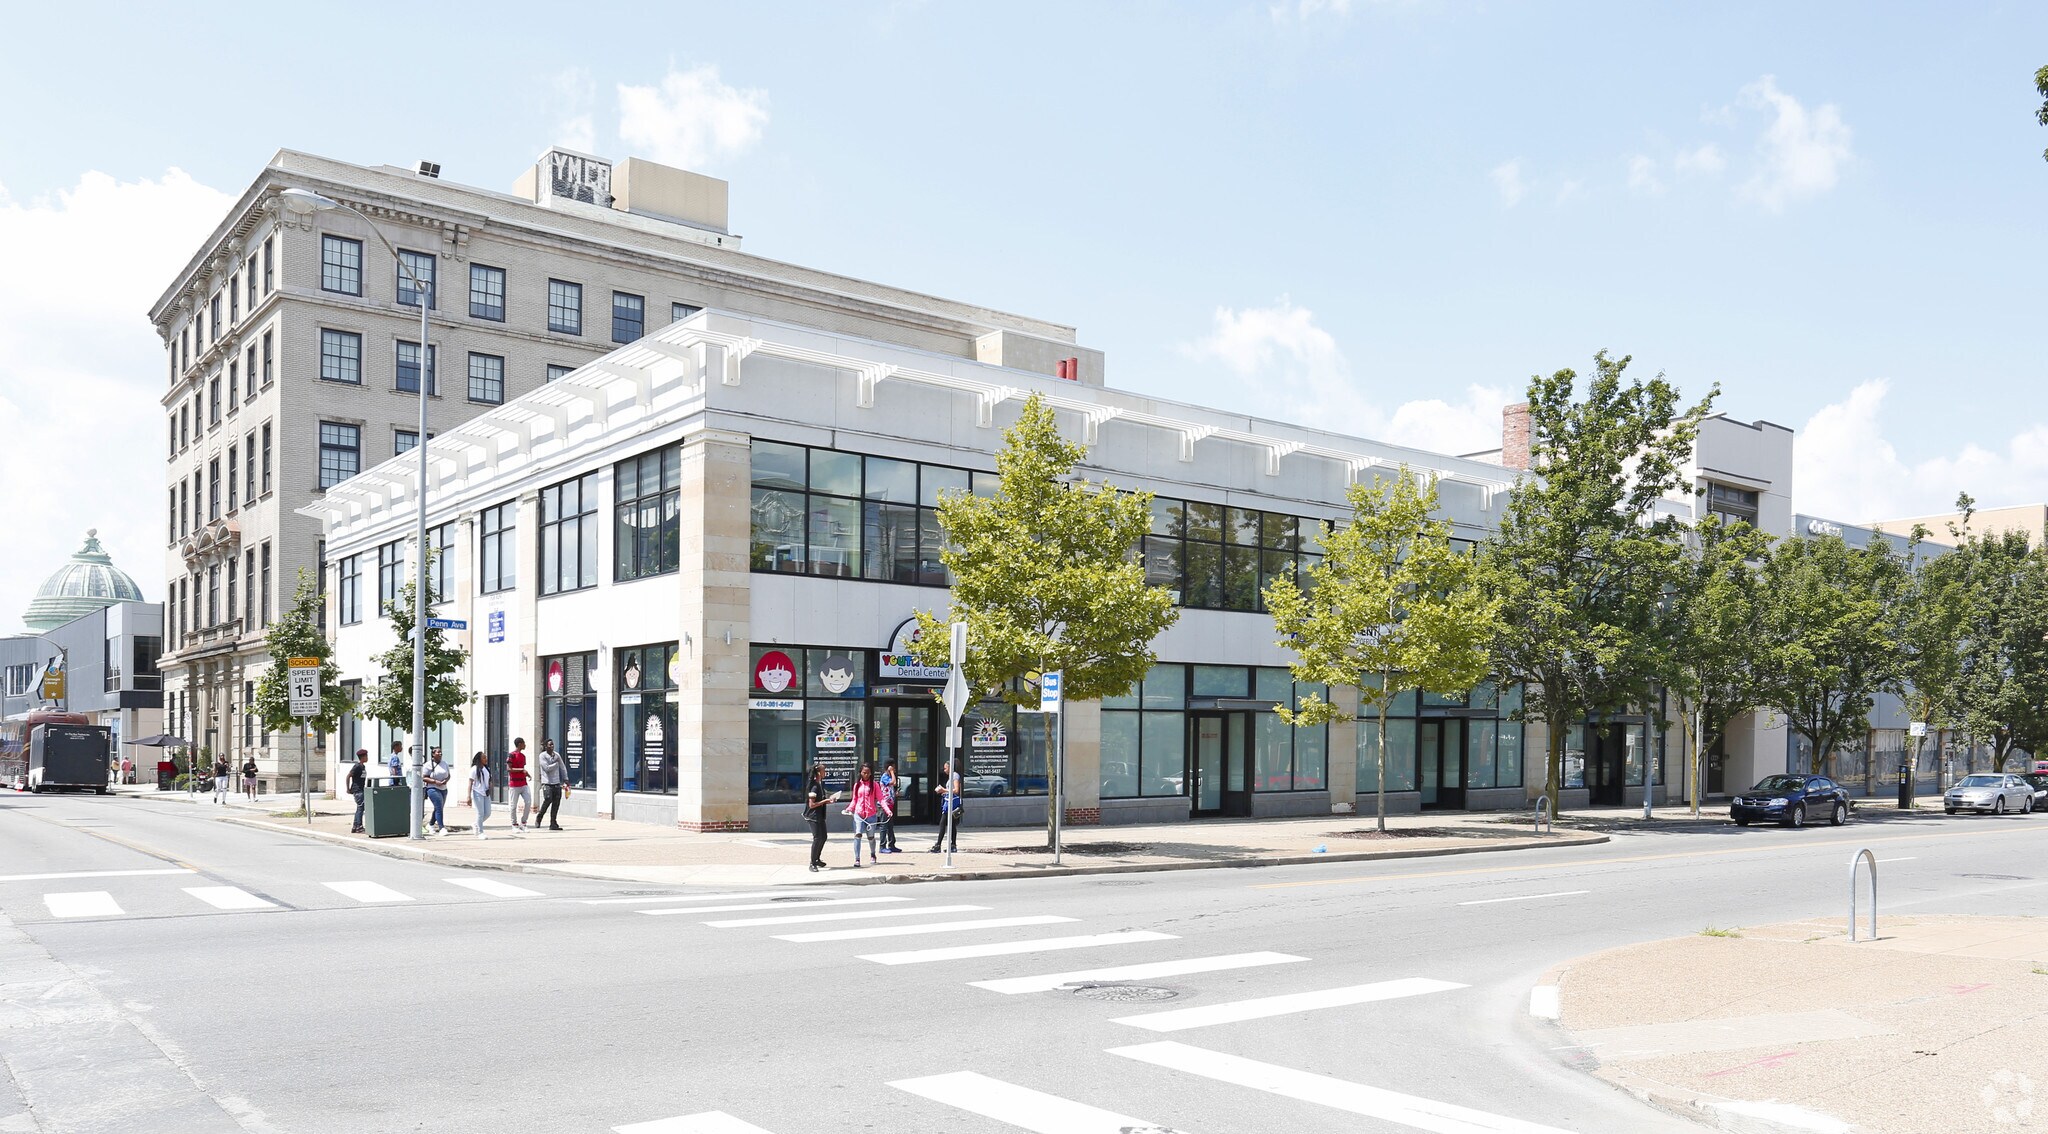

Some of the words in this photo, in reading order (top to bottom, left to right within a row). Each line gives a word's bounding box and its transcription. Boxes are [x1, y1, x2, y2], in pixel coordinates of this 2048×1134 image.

[430, 619, 448, 628] Penn
[451, 621, 464, 629] Ave
[898, 668, 921, 676] Dental
[924, 668, 947, 678] Center
[1045, 677, 1057, 686] Bus
[295, 685, 314, 698] 15
[1042, 689, 1058, 698] Stop
